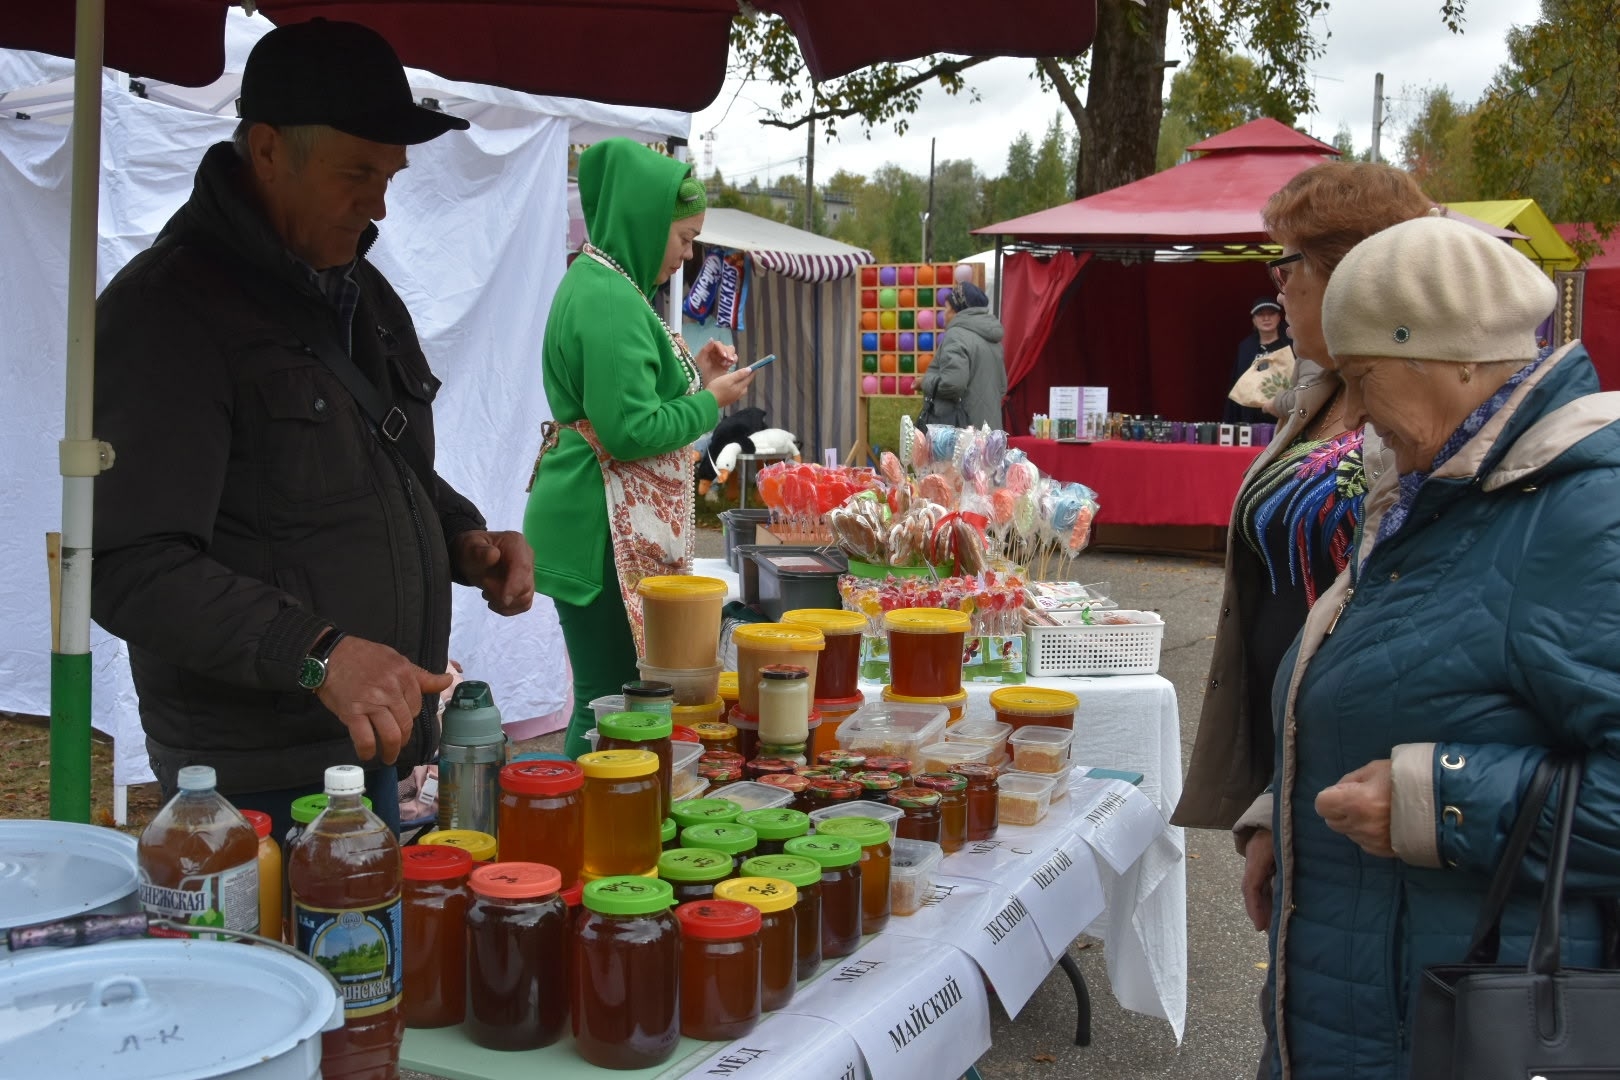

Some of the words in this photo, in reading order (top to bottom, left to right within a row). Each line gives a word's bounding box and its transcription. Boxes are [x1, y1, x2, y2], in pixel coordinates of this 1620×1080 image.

[718, 263, 738, 328] SNICKERS
[1084, 792, 1127, 828] ЛУГОВОЙ
[1030, 848, 1073, 890] ПЕРГОЙ
[983, 894, 1028, 945] ЛЕСНОЙ
[833, 960, 885, 983] МЁД
[888, 975, 964, 1053] МАЙСКИЙ
[707, 1047, 772, 1077] МЁД
